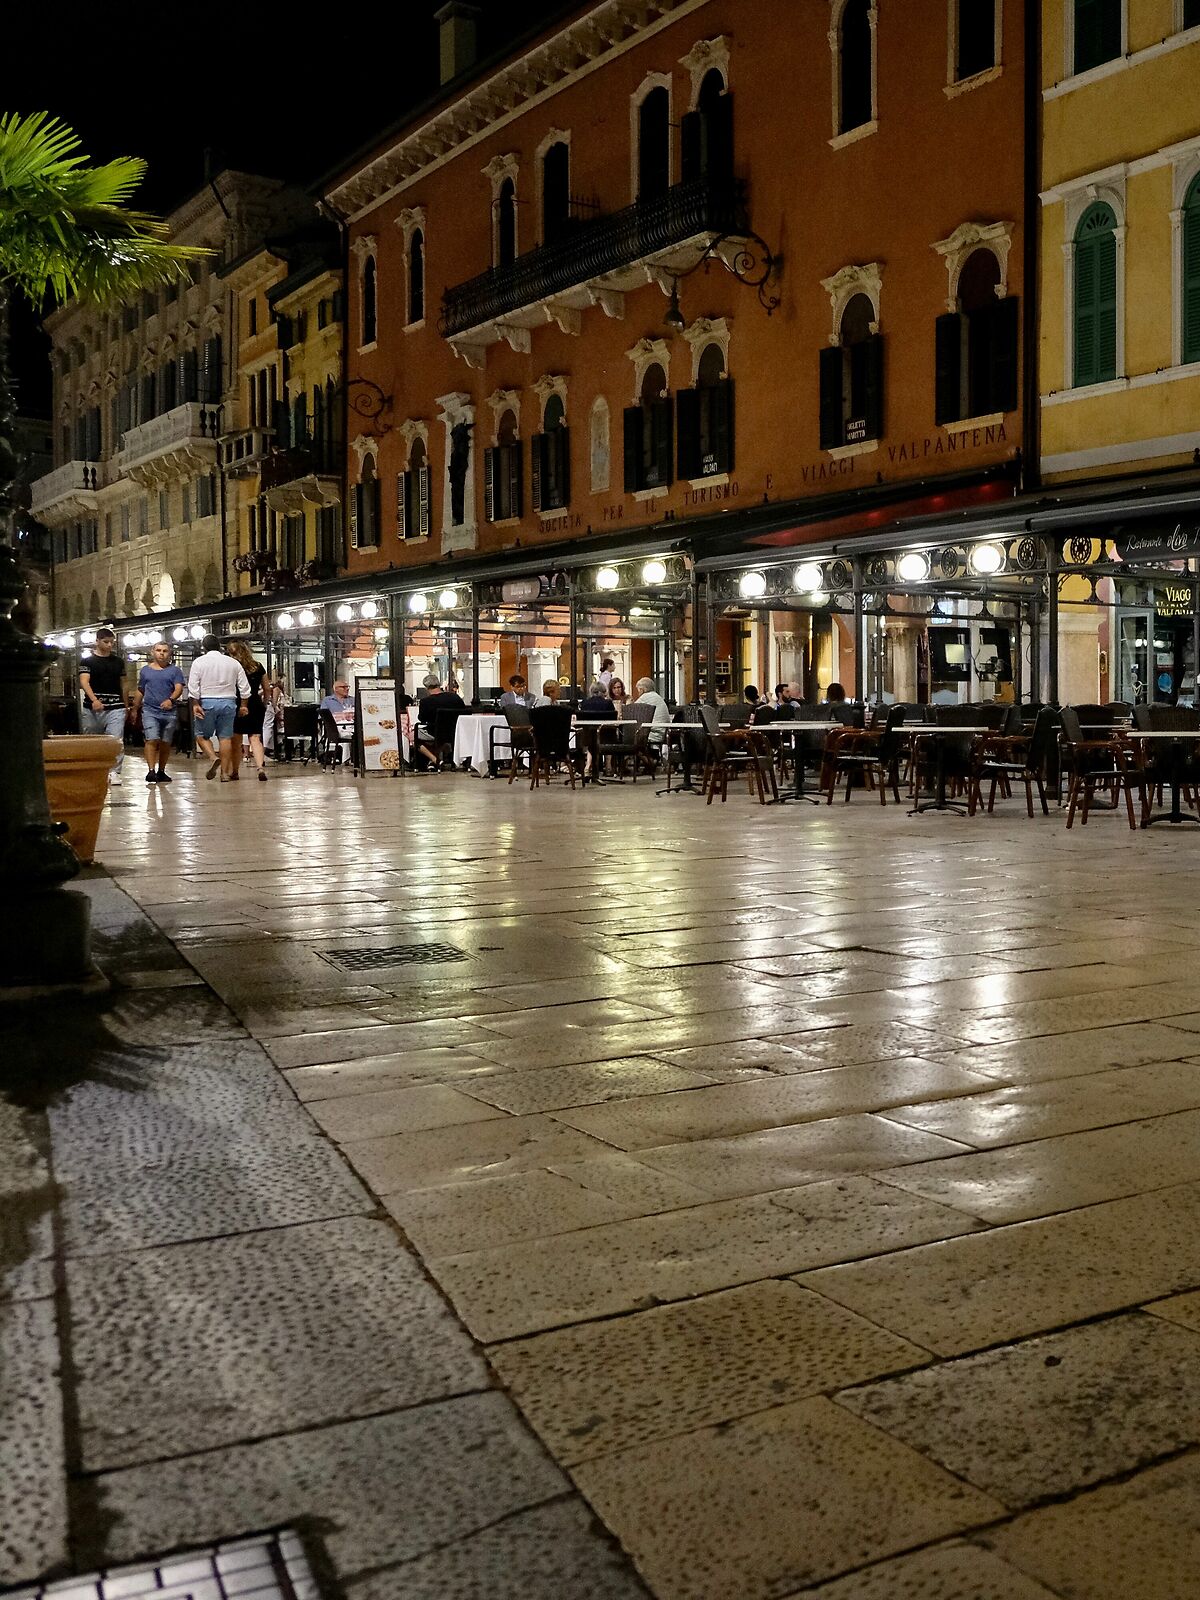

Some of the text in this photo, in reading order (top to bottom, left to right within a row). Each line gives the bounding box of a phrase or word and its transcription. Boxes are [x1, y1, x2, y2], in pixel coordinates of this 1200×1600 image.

[603, 505, 623, 521] PER
[645, 499, 657, 515] IL
[685, 483, 739, 505] TURISMO
[766, 473, 774, 490] E
[802, 458, 855, 482] VIAGGI
[888, 425, 1007, 462] VALPANTENA
